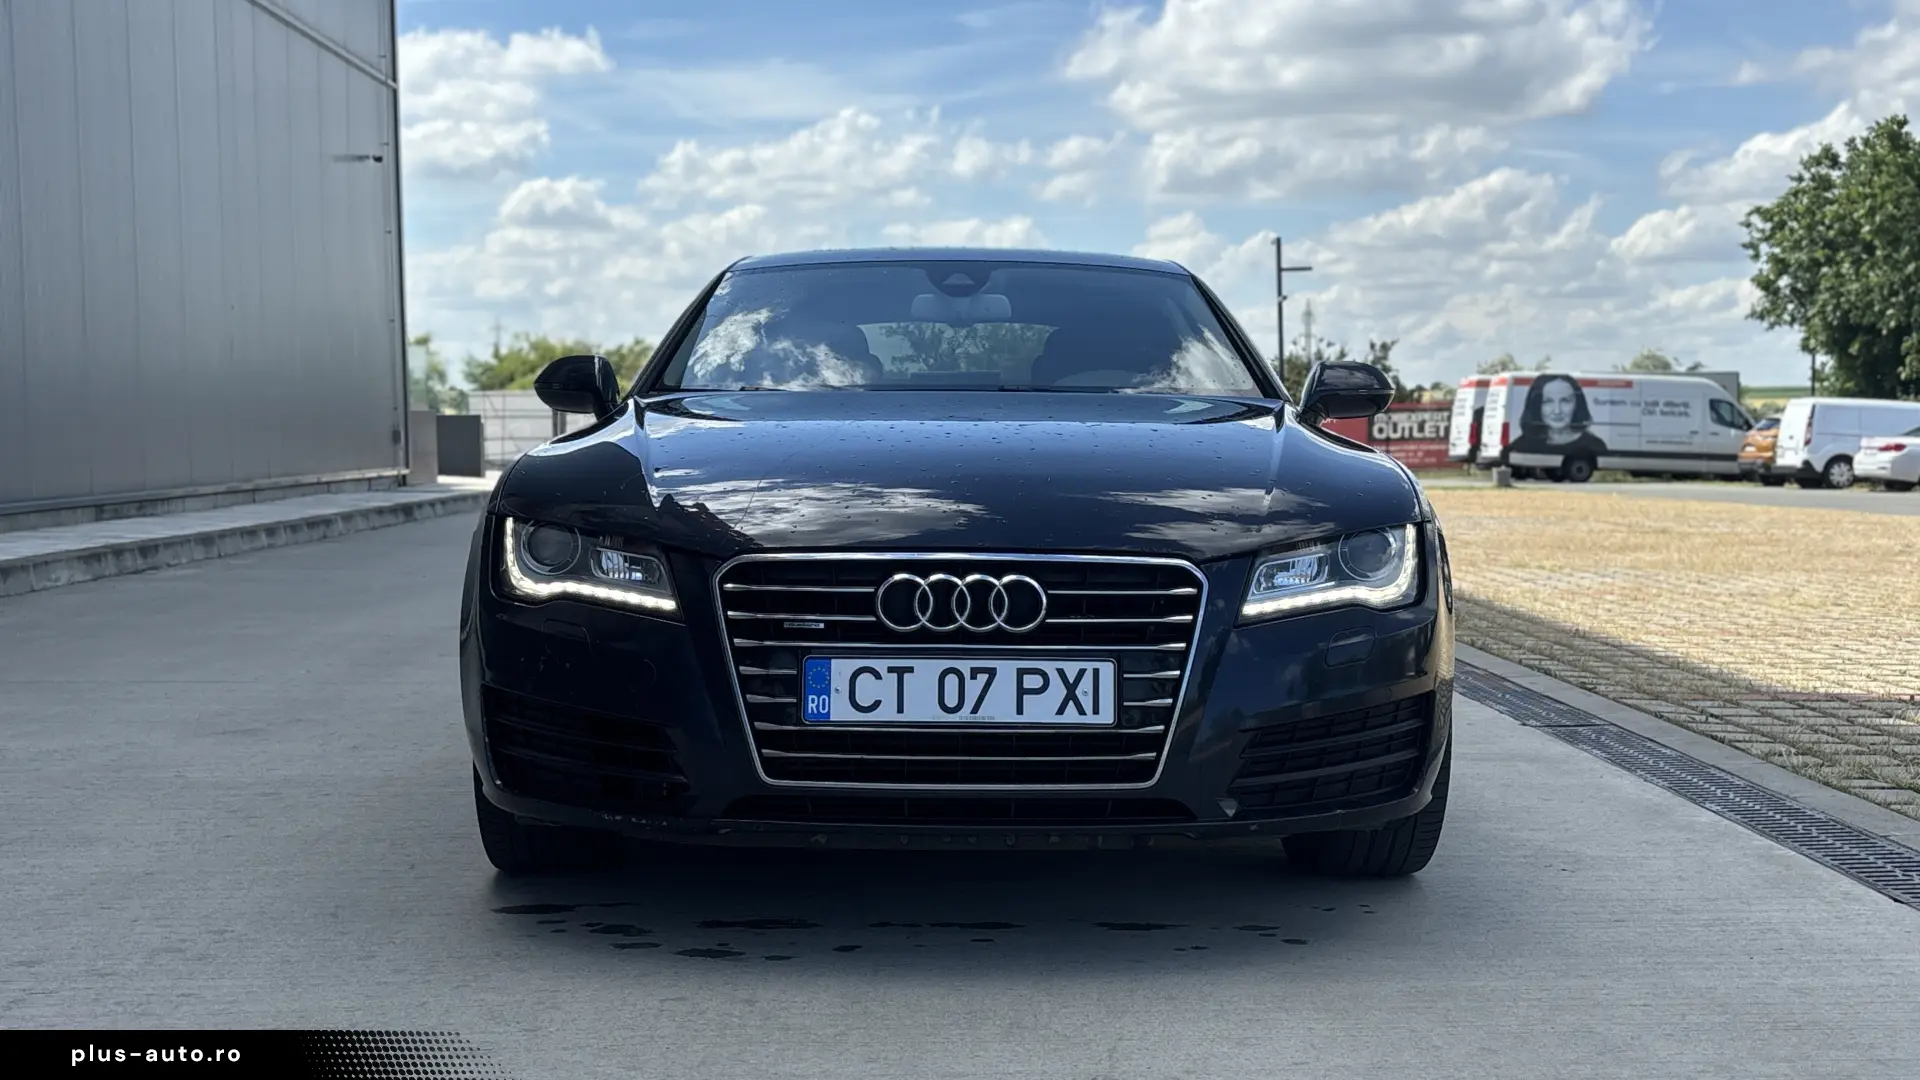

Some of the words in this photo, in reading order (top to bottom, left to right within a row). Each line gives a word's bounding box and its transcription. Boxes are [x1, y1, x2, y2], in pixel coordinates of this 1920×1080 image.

[1372, 422, 1449, 439] OUTLET
[848, 666, 915, 715] CT
[937, 666, 998, 715] 07
[1015, 667, 1101, 716] PXI
[808, 695, 830, 714] RO
